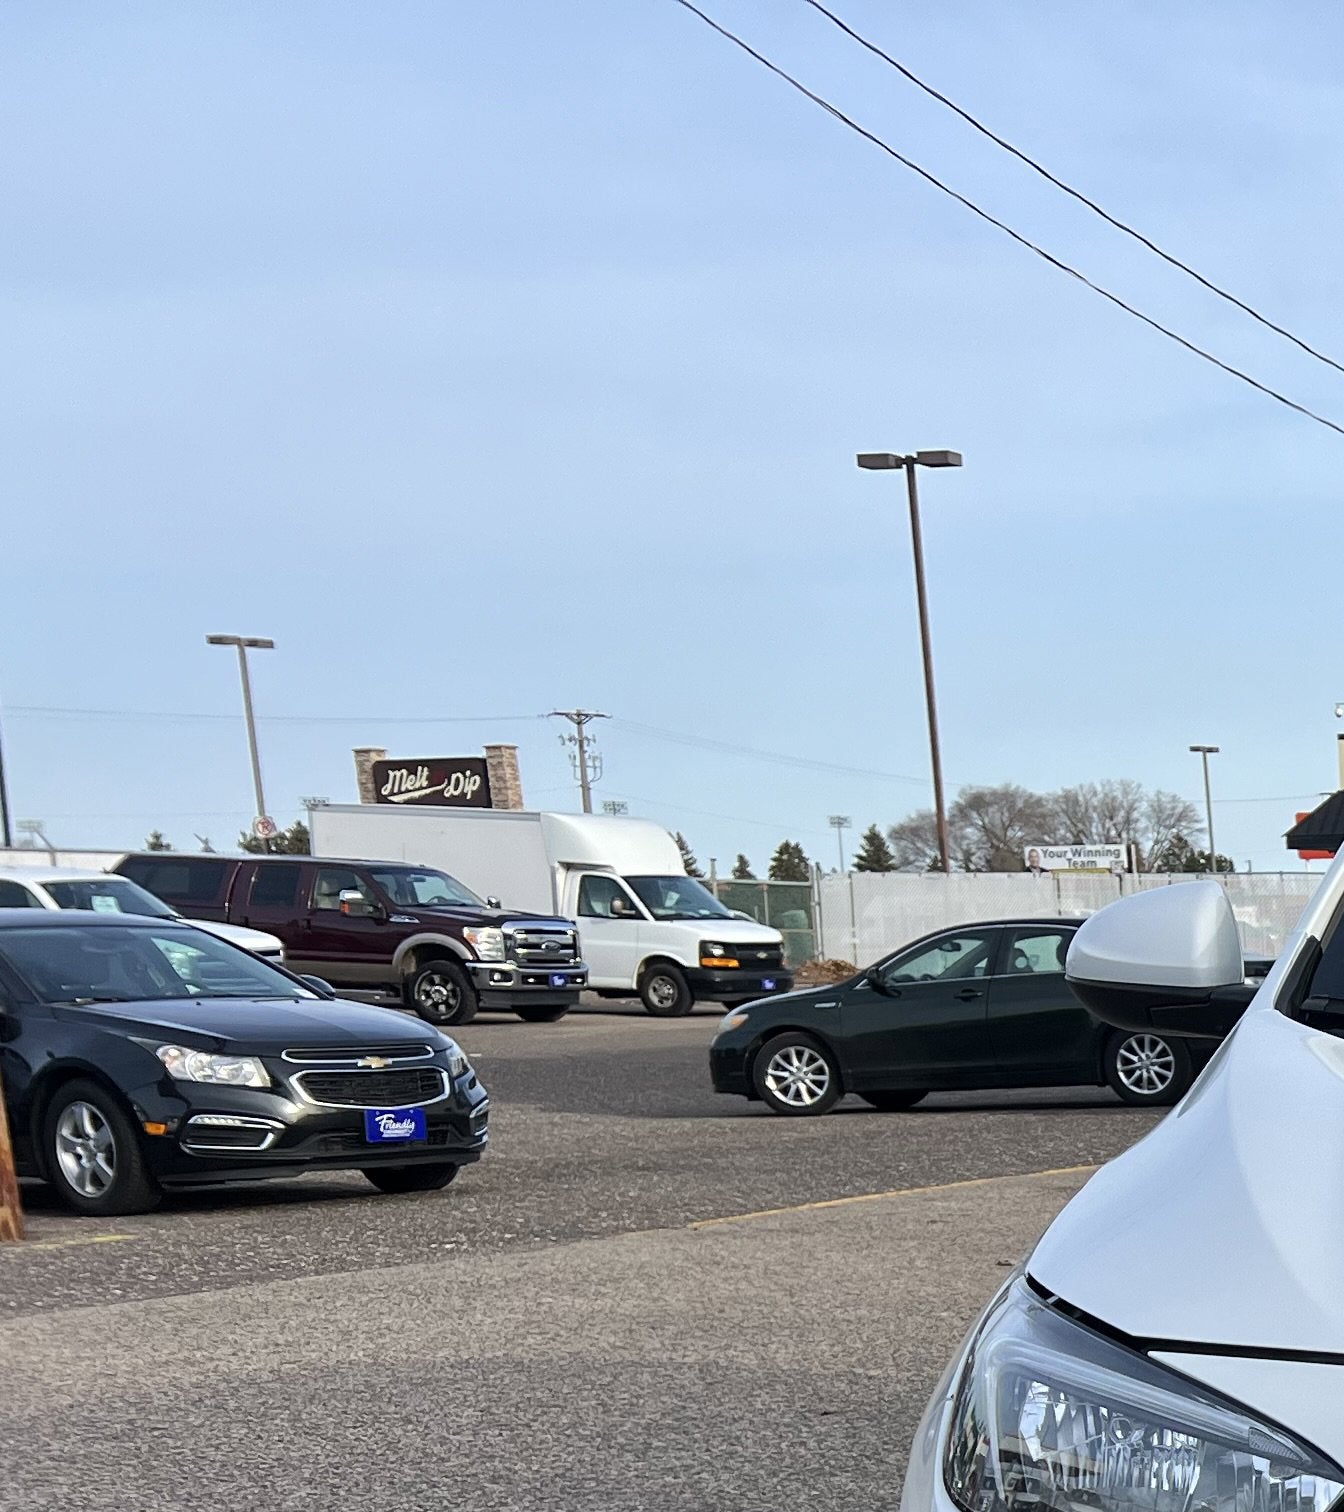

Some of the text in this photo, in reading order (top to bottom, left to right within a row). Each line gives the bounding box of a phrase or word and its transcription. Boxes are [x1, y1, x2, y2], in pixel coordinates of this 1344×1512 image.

[381, 765, 481, 800] Melt Dip
[1041, 847, 1121, 859] Your Winning
[1066, 858, 1098, 868] Team
